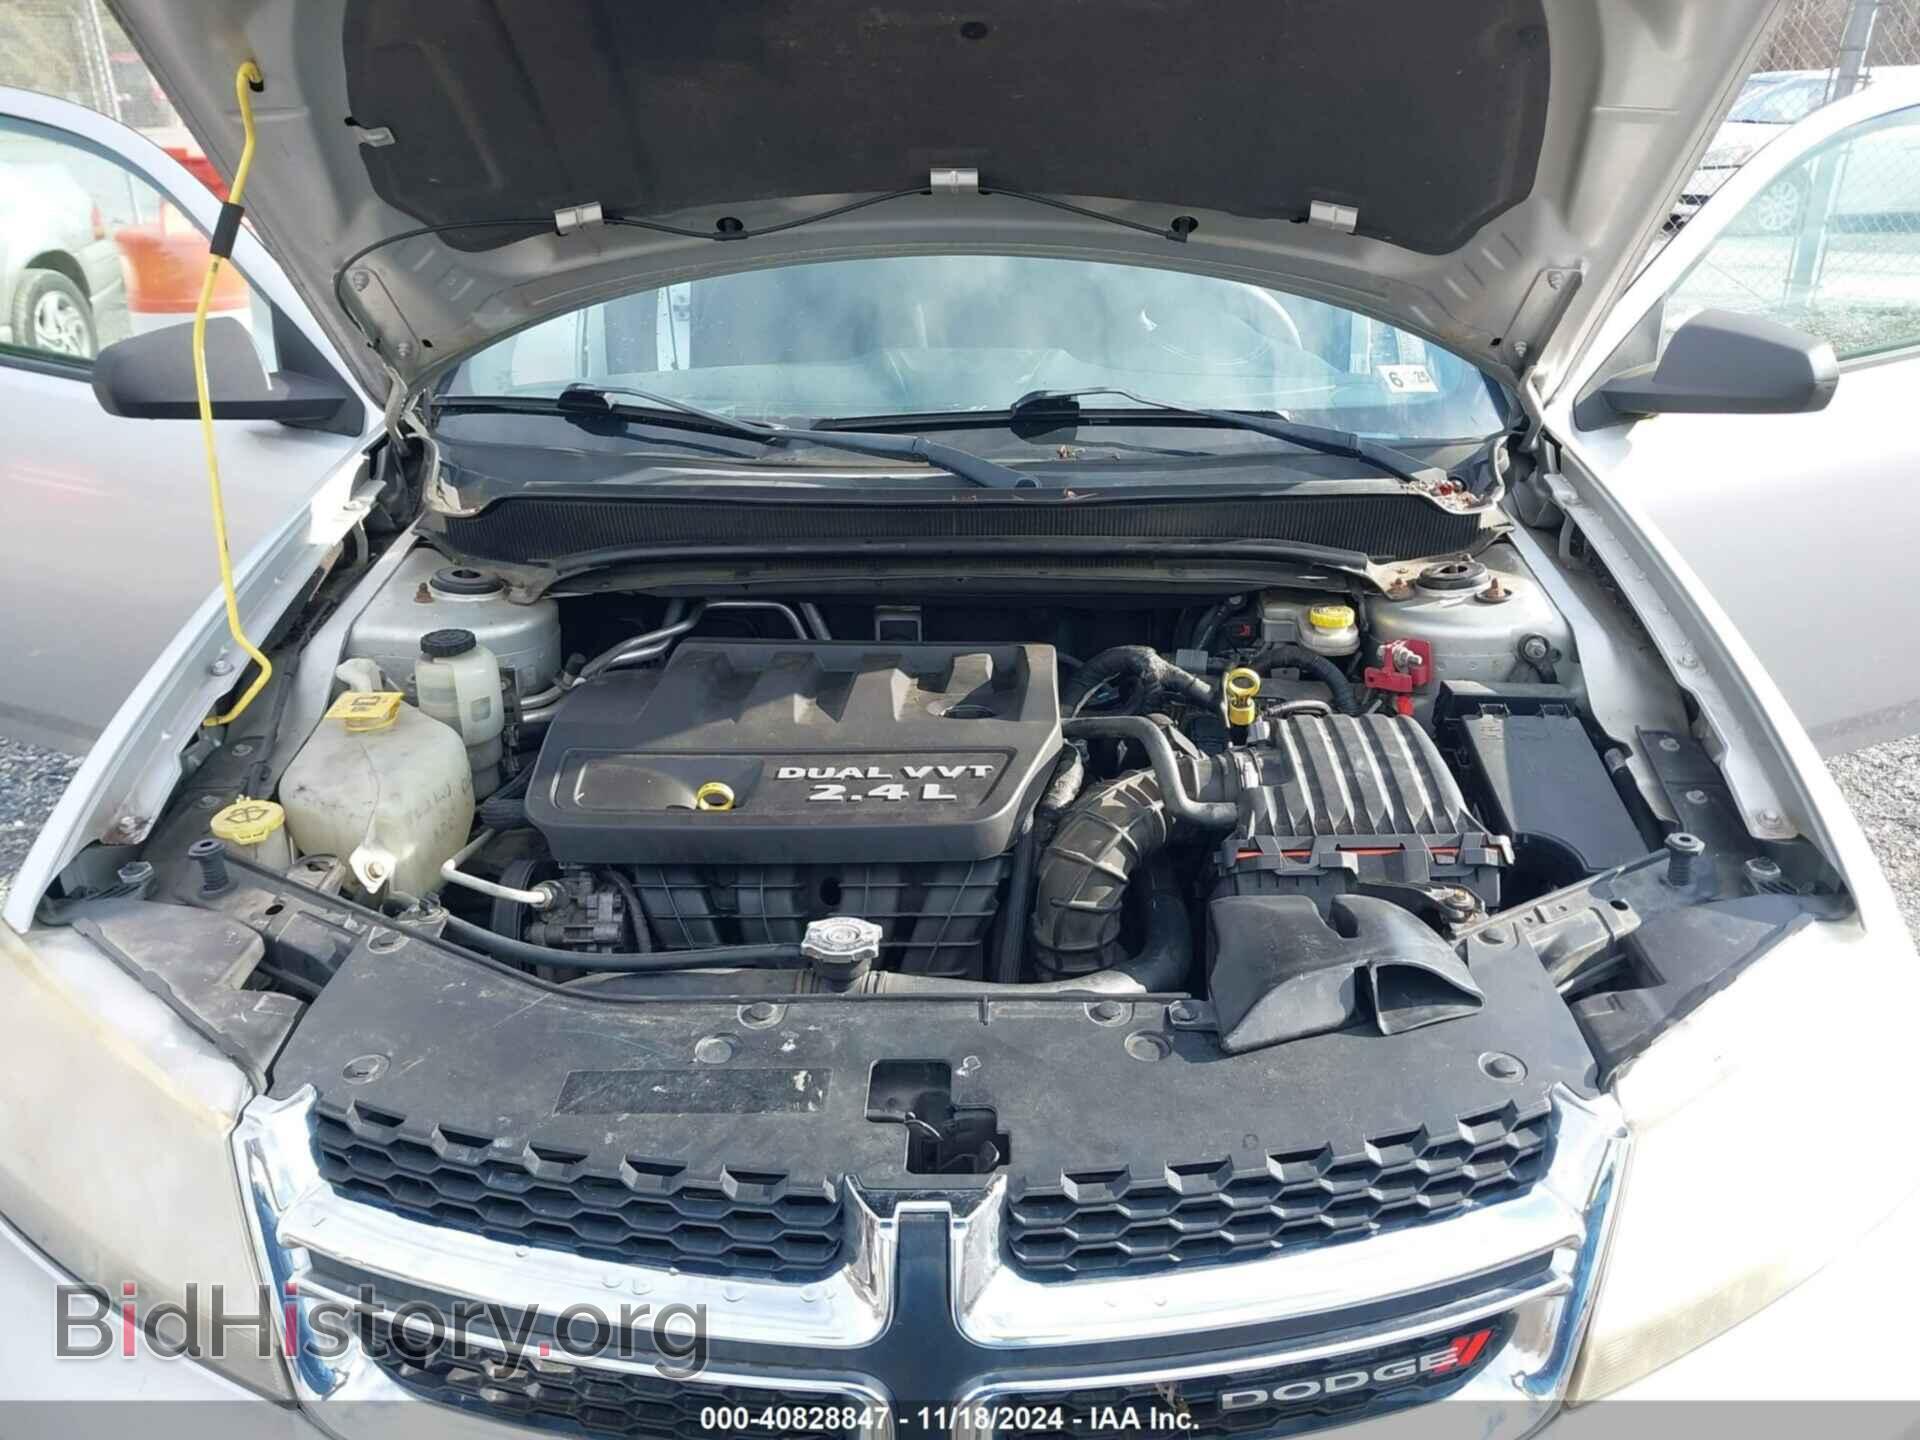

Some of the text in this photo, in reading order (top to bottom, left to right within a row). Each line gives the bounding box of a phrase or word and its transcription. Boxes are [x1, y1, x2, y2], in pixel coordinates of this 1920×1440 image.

[1388, 371, 1404, 388] 6
[776, 764, 994, 780] DUAL VVT
[1221, 1346, 1459, 1410] DODGE
